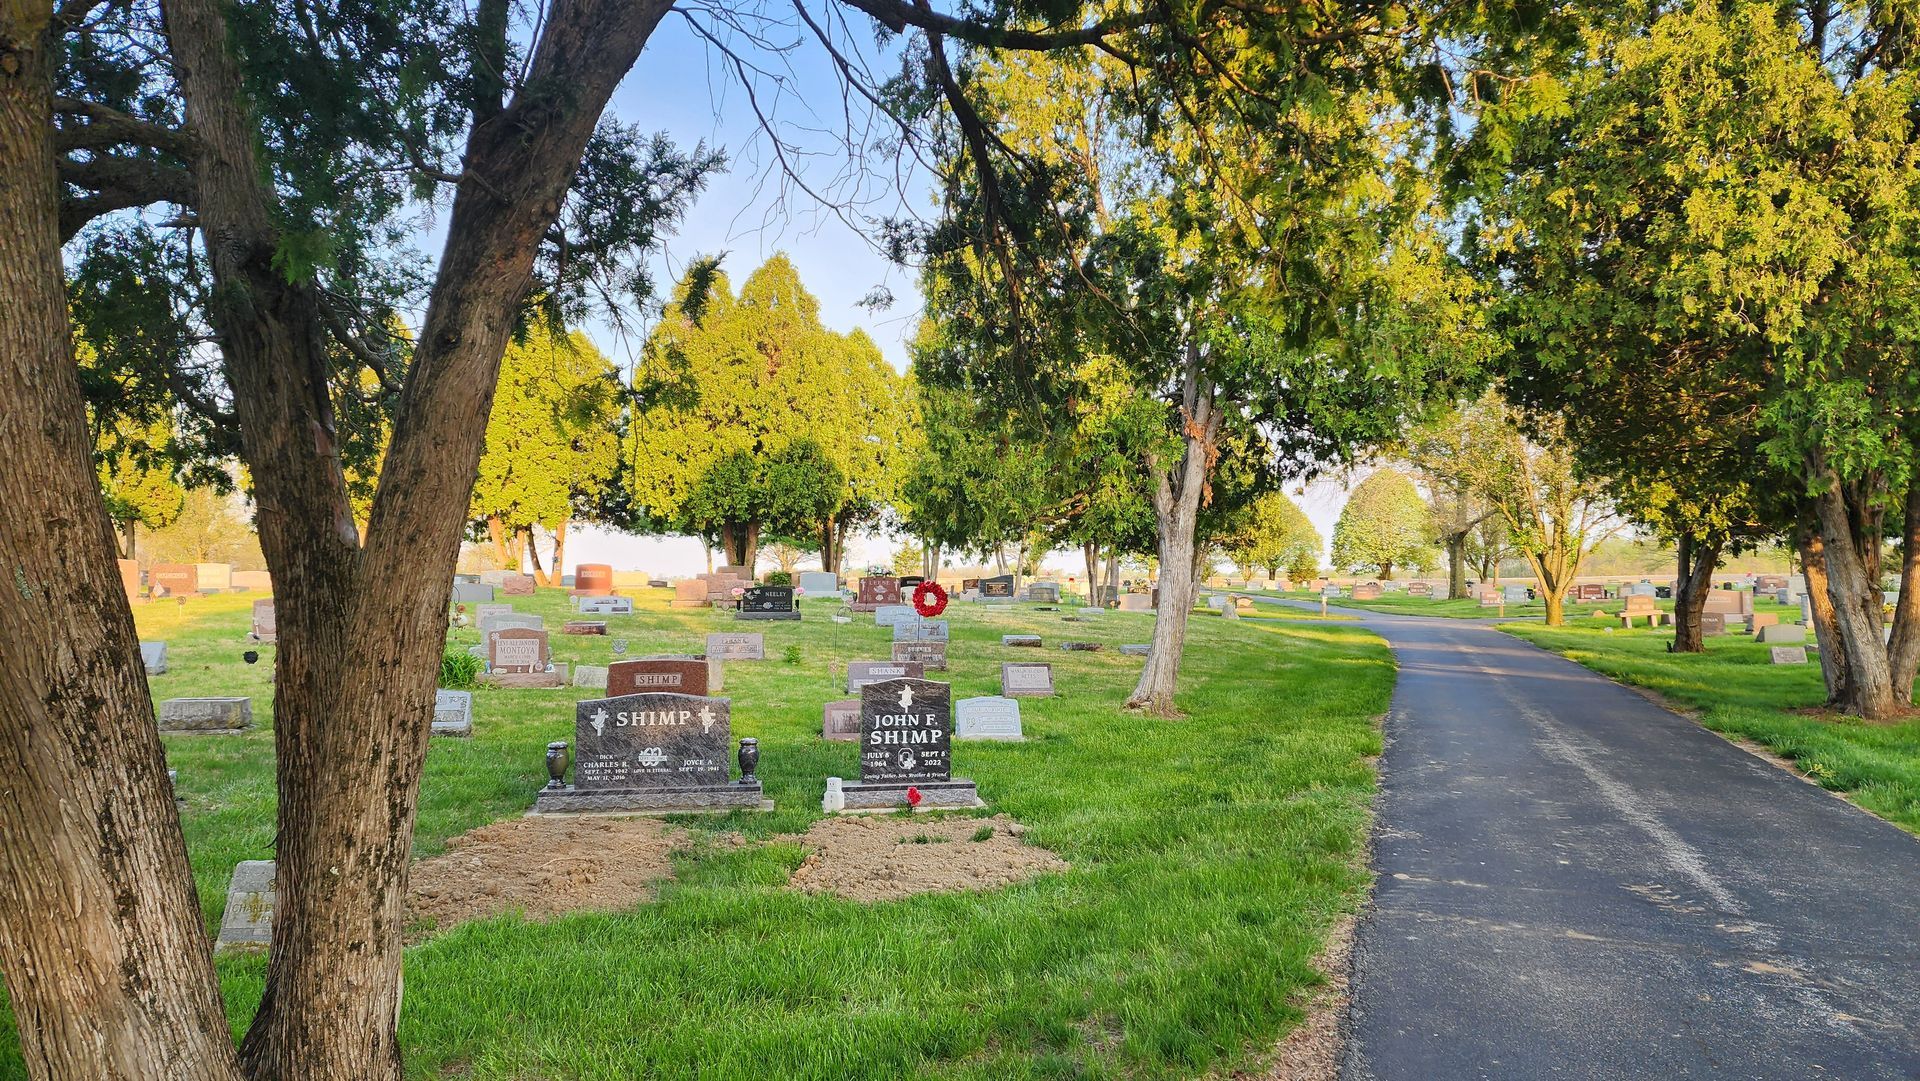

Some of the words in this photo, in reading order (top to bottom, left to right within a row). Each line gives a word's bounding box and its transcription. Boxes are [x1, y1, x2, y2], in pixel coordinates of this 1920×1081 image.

[499, 646, 535, 655] MONTOYA
[639, 675, 679, 685] SHIMP
[616, 710, 691, 727] SHIMP
[874, 714, 920, 730] JOHN
[925, 713, 938, 726] F.
[870, 729, 943, 745] SHIMP
